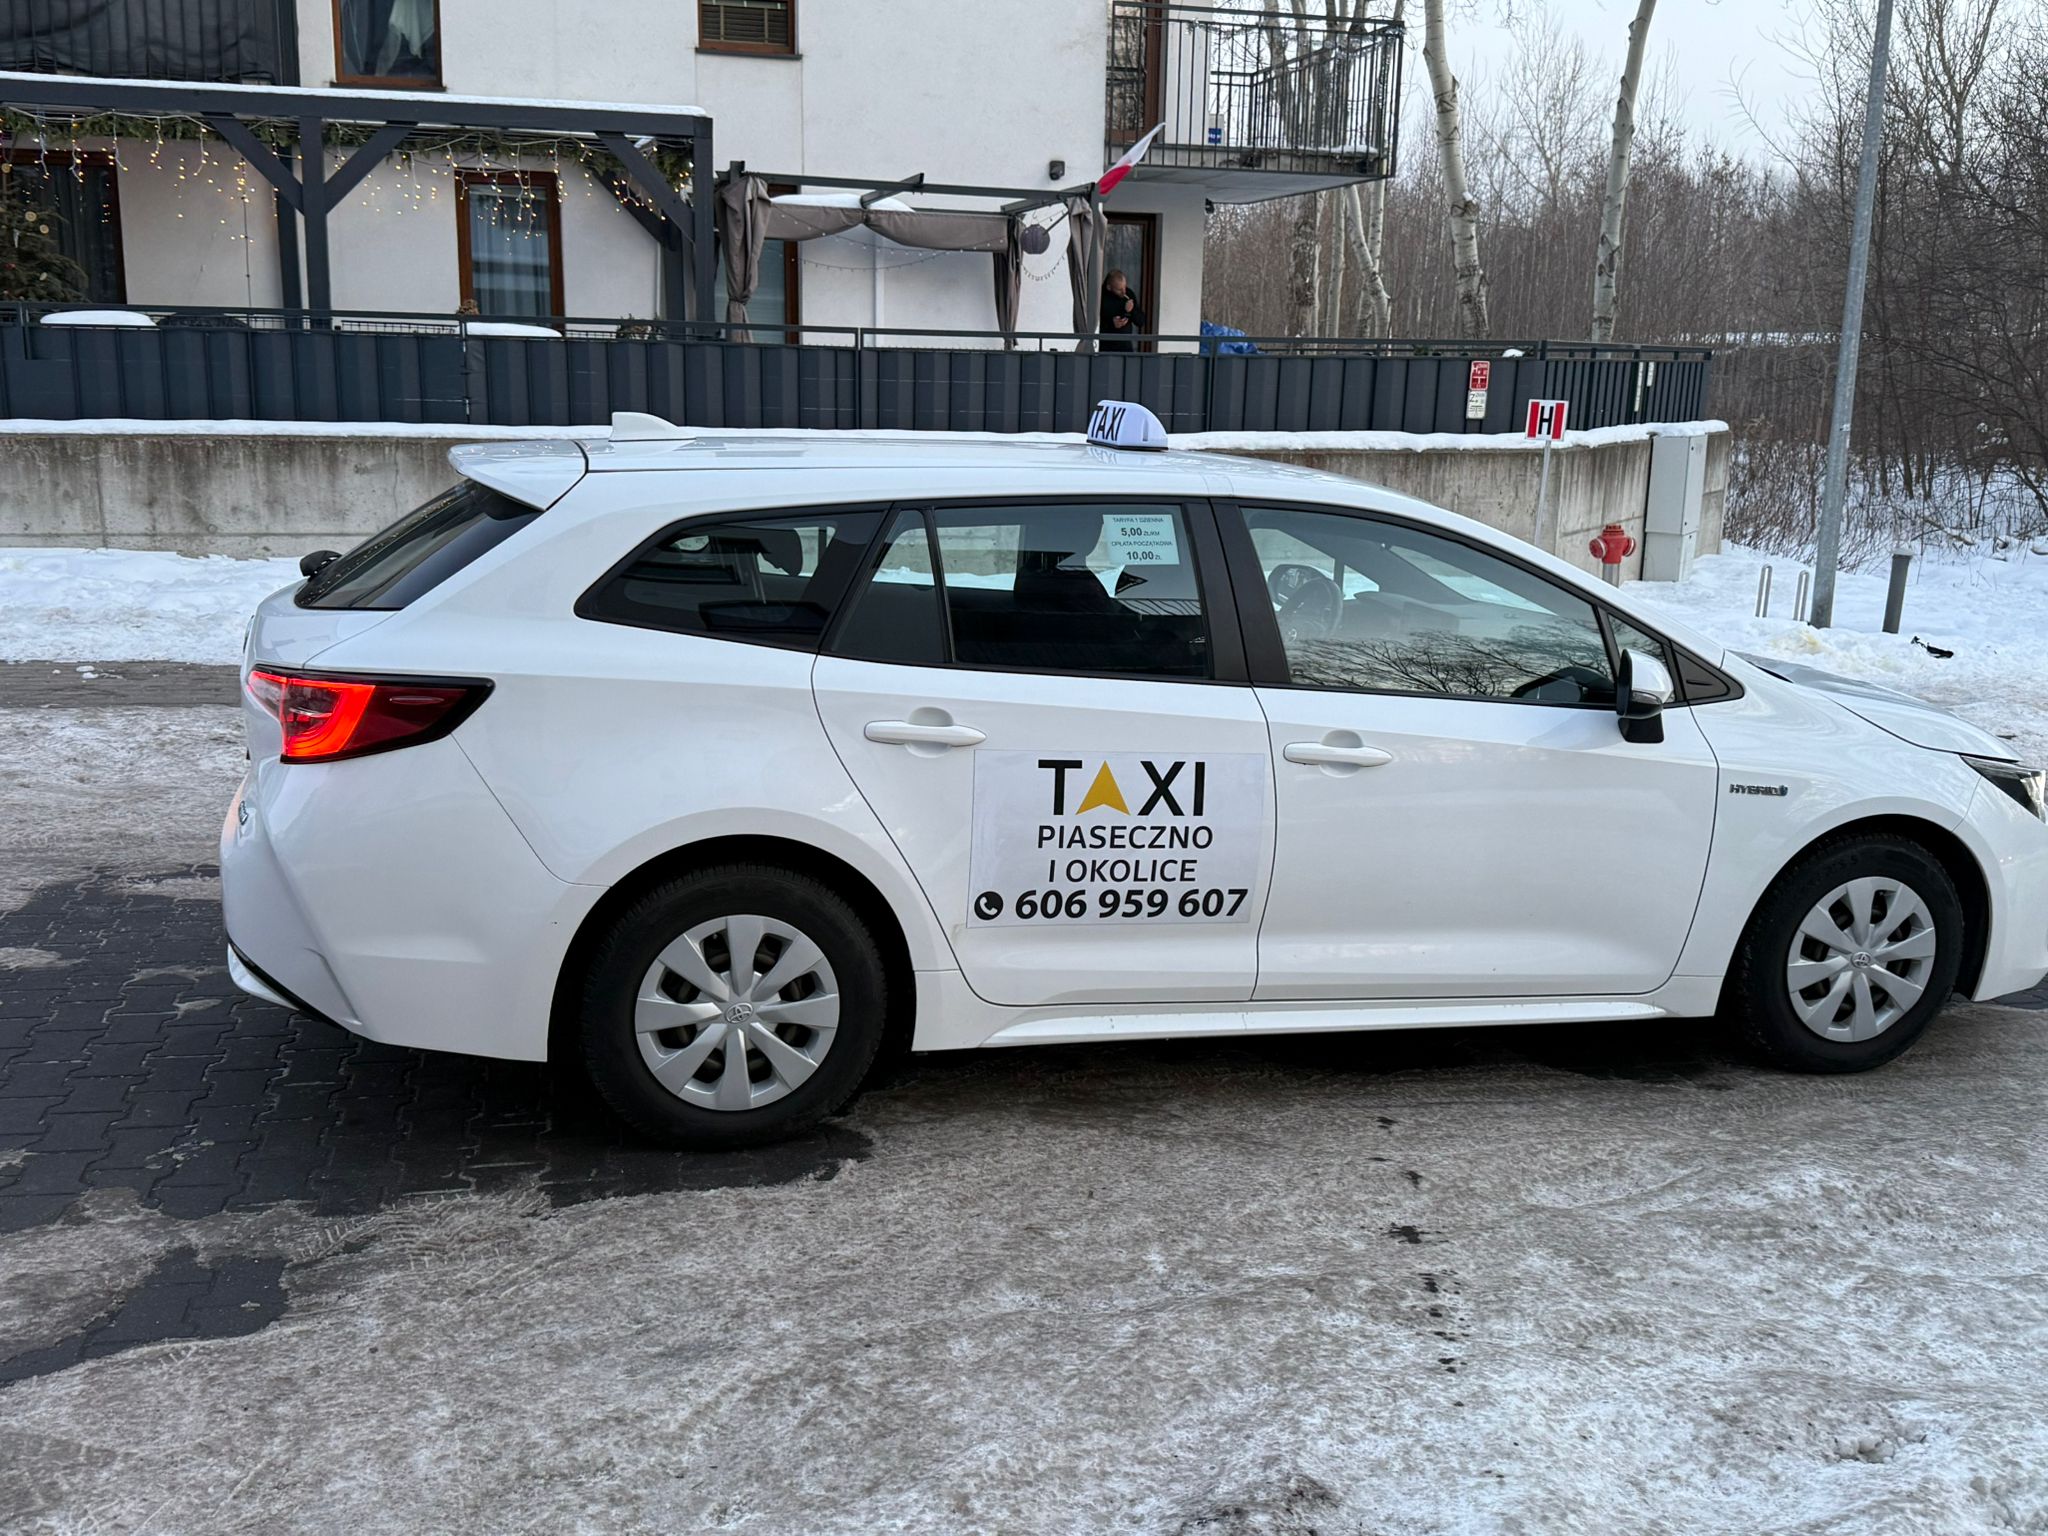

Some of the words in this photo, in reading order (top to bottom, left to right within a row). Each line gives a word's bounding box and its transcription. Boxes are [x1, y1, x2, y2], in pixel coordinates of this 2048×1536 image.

[1091, 406, 1126, 441] TAXI
[1538, 406, 1554, 435] H
[1121, 527, 1142, 537] 5,00
[1127, 551, 1154, 561] 10,00
[1038, 759, 1206, 816] TAXI
[1729, 784, 1779, 796] HYBRID
[1037, 825, 1213, 849] PIASECZNO
[1048, 860, 1056, 882] I
[1065, 859, 1197, 882] OKOLICE
[1015, 889, 1087, 919] 606
[1098, 889, 1169, 918] 959
[1178, 888, 1248, 918] 607
